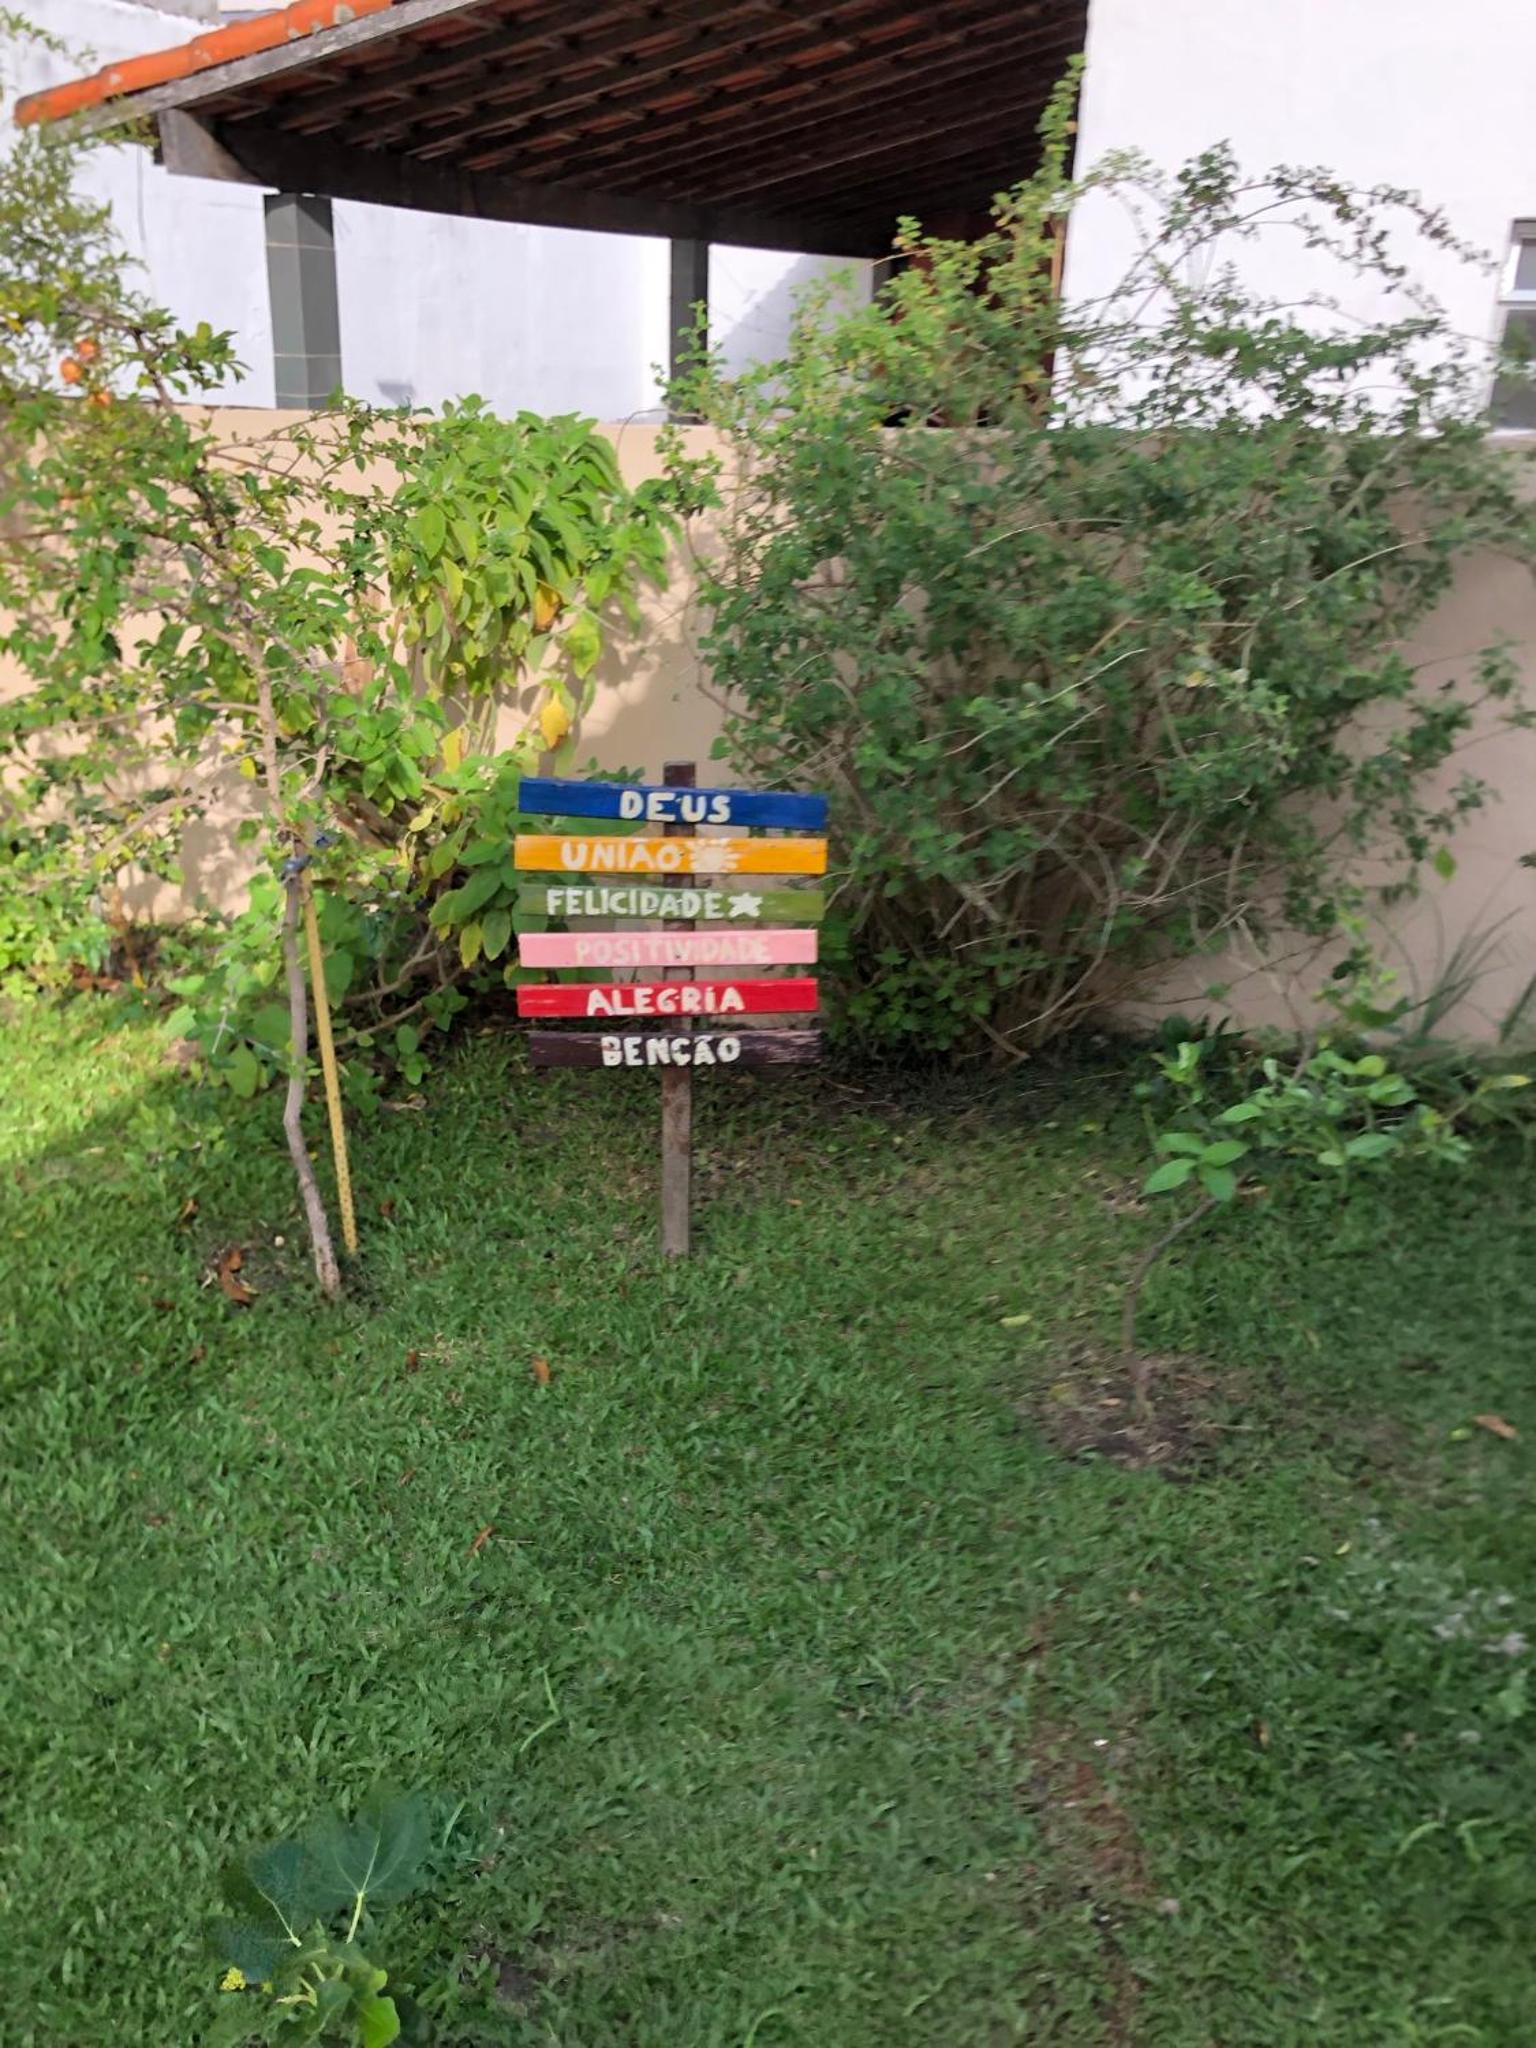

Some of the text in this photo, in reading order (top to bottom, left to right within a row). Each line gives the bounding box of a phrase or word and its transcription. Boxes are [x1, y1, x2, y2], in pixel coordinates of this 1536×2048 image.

[619, 790, 731, 823] DEUS
[546, 888, 724, 919] FELICIDADE
[575, 936, 774, 964] POSITIVIDADE
[601, 1035, 741, 1066] BENÇÃO
